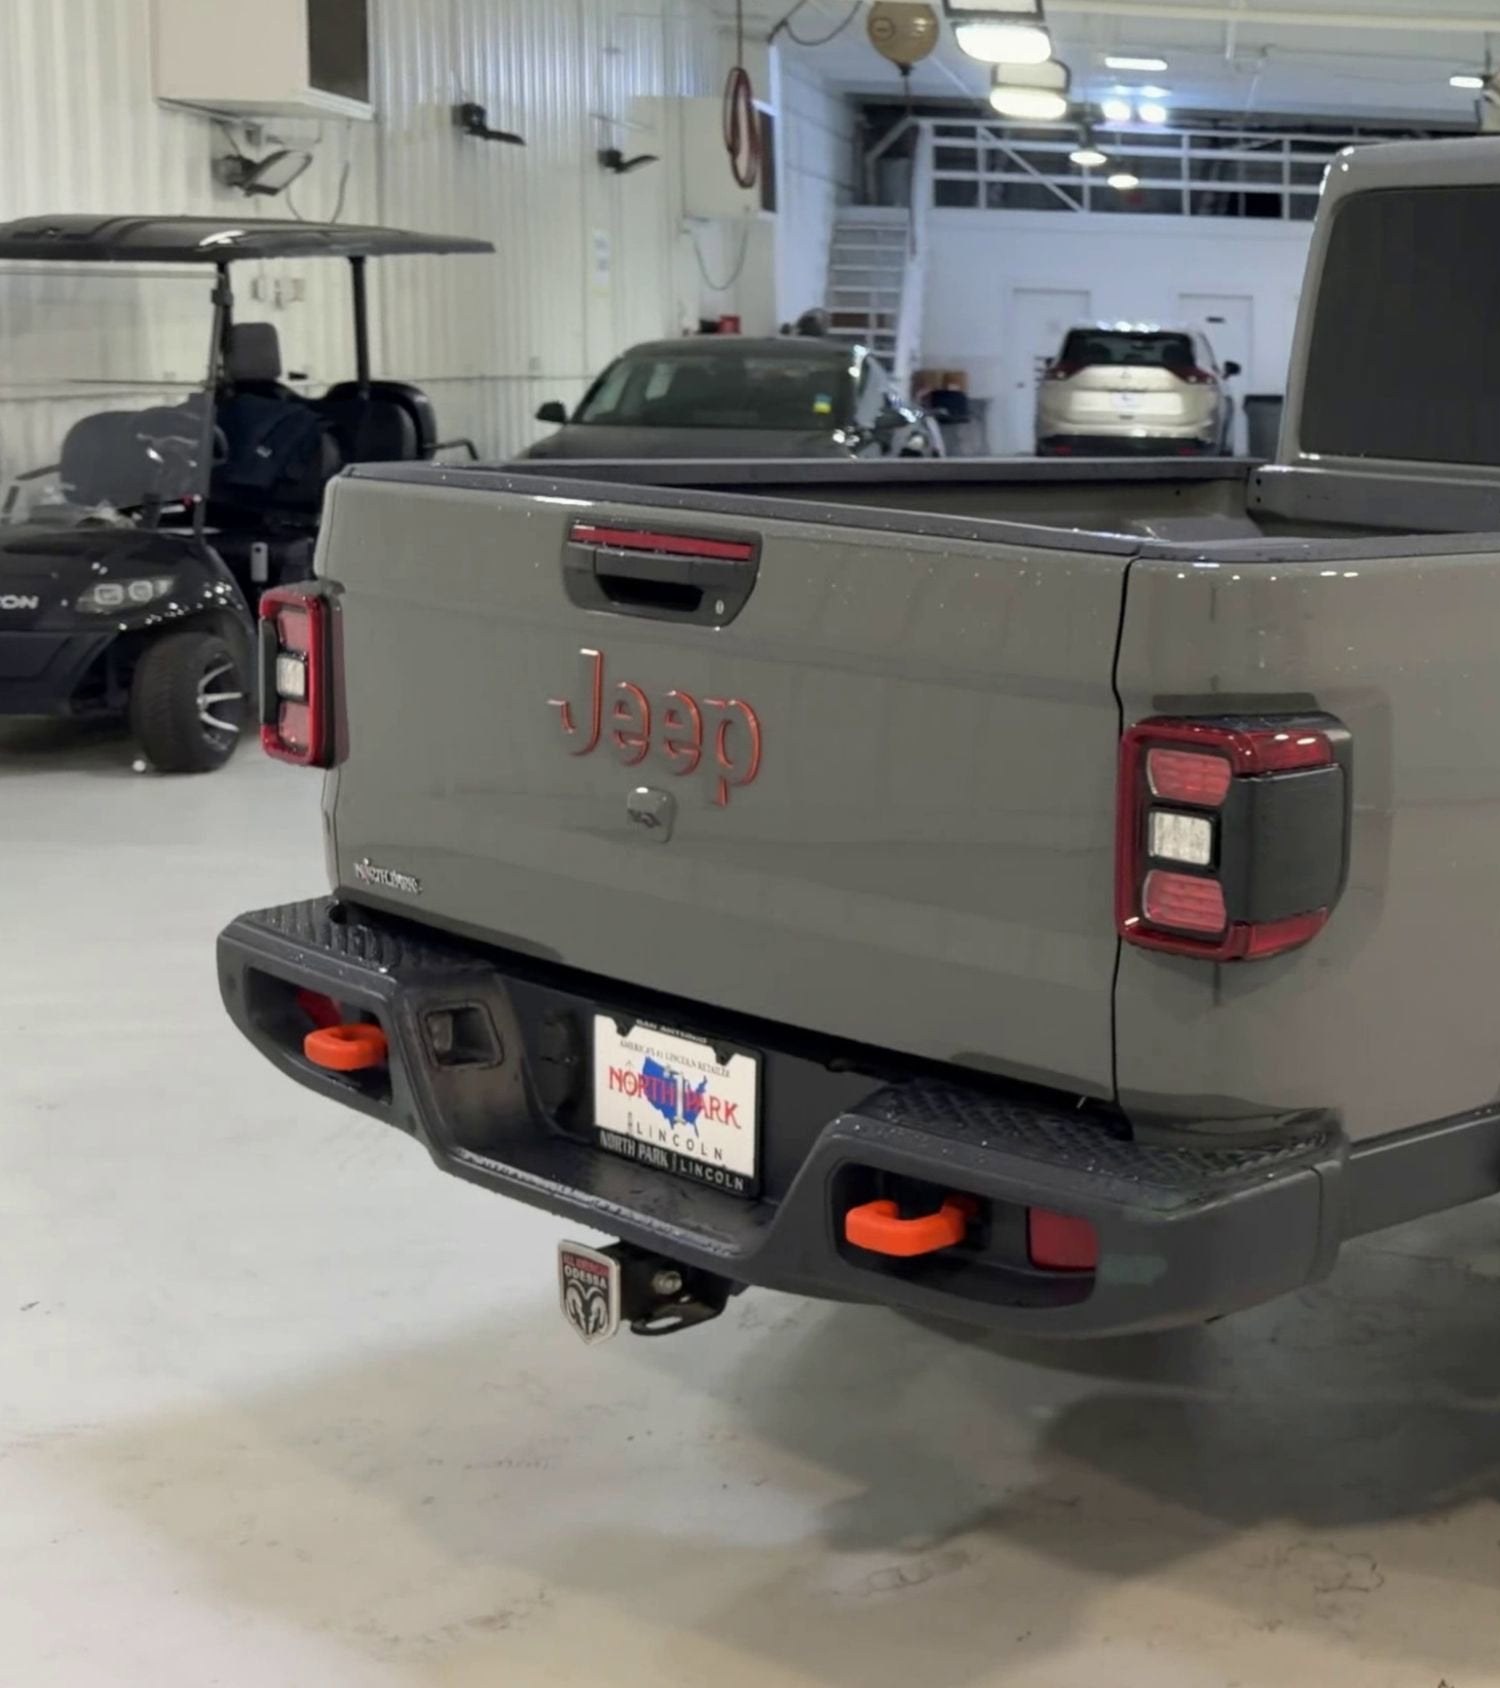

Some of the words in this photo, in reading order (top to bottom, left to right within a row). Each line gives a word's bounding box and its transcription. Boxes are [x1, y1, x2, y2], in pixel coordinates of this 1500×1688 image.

[0, 595, 39, 609] ON
[547, 648, 762, 808] Jeep
[609, 1066, 677, 1112] NORTH
[683, 1085, 741, 1129] PARK
[601, 1130, 636, 1157] NORTH
[637, 1142, 669, 1169] PARK
[679, 1160, 744, 1192] LINCOLN
[636, 1121, 723, 1161] LINCOLN
[564, 1264, 608, 1290] ODESSA
